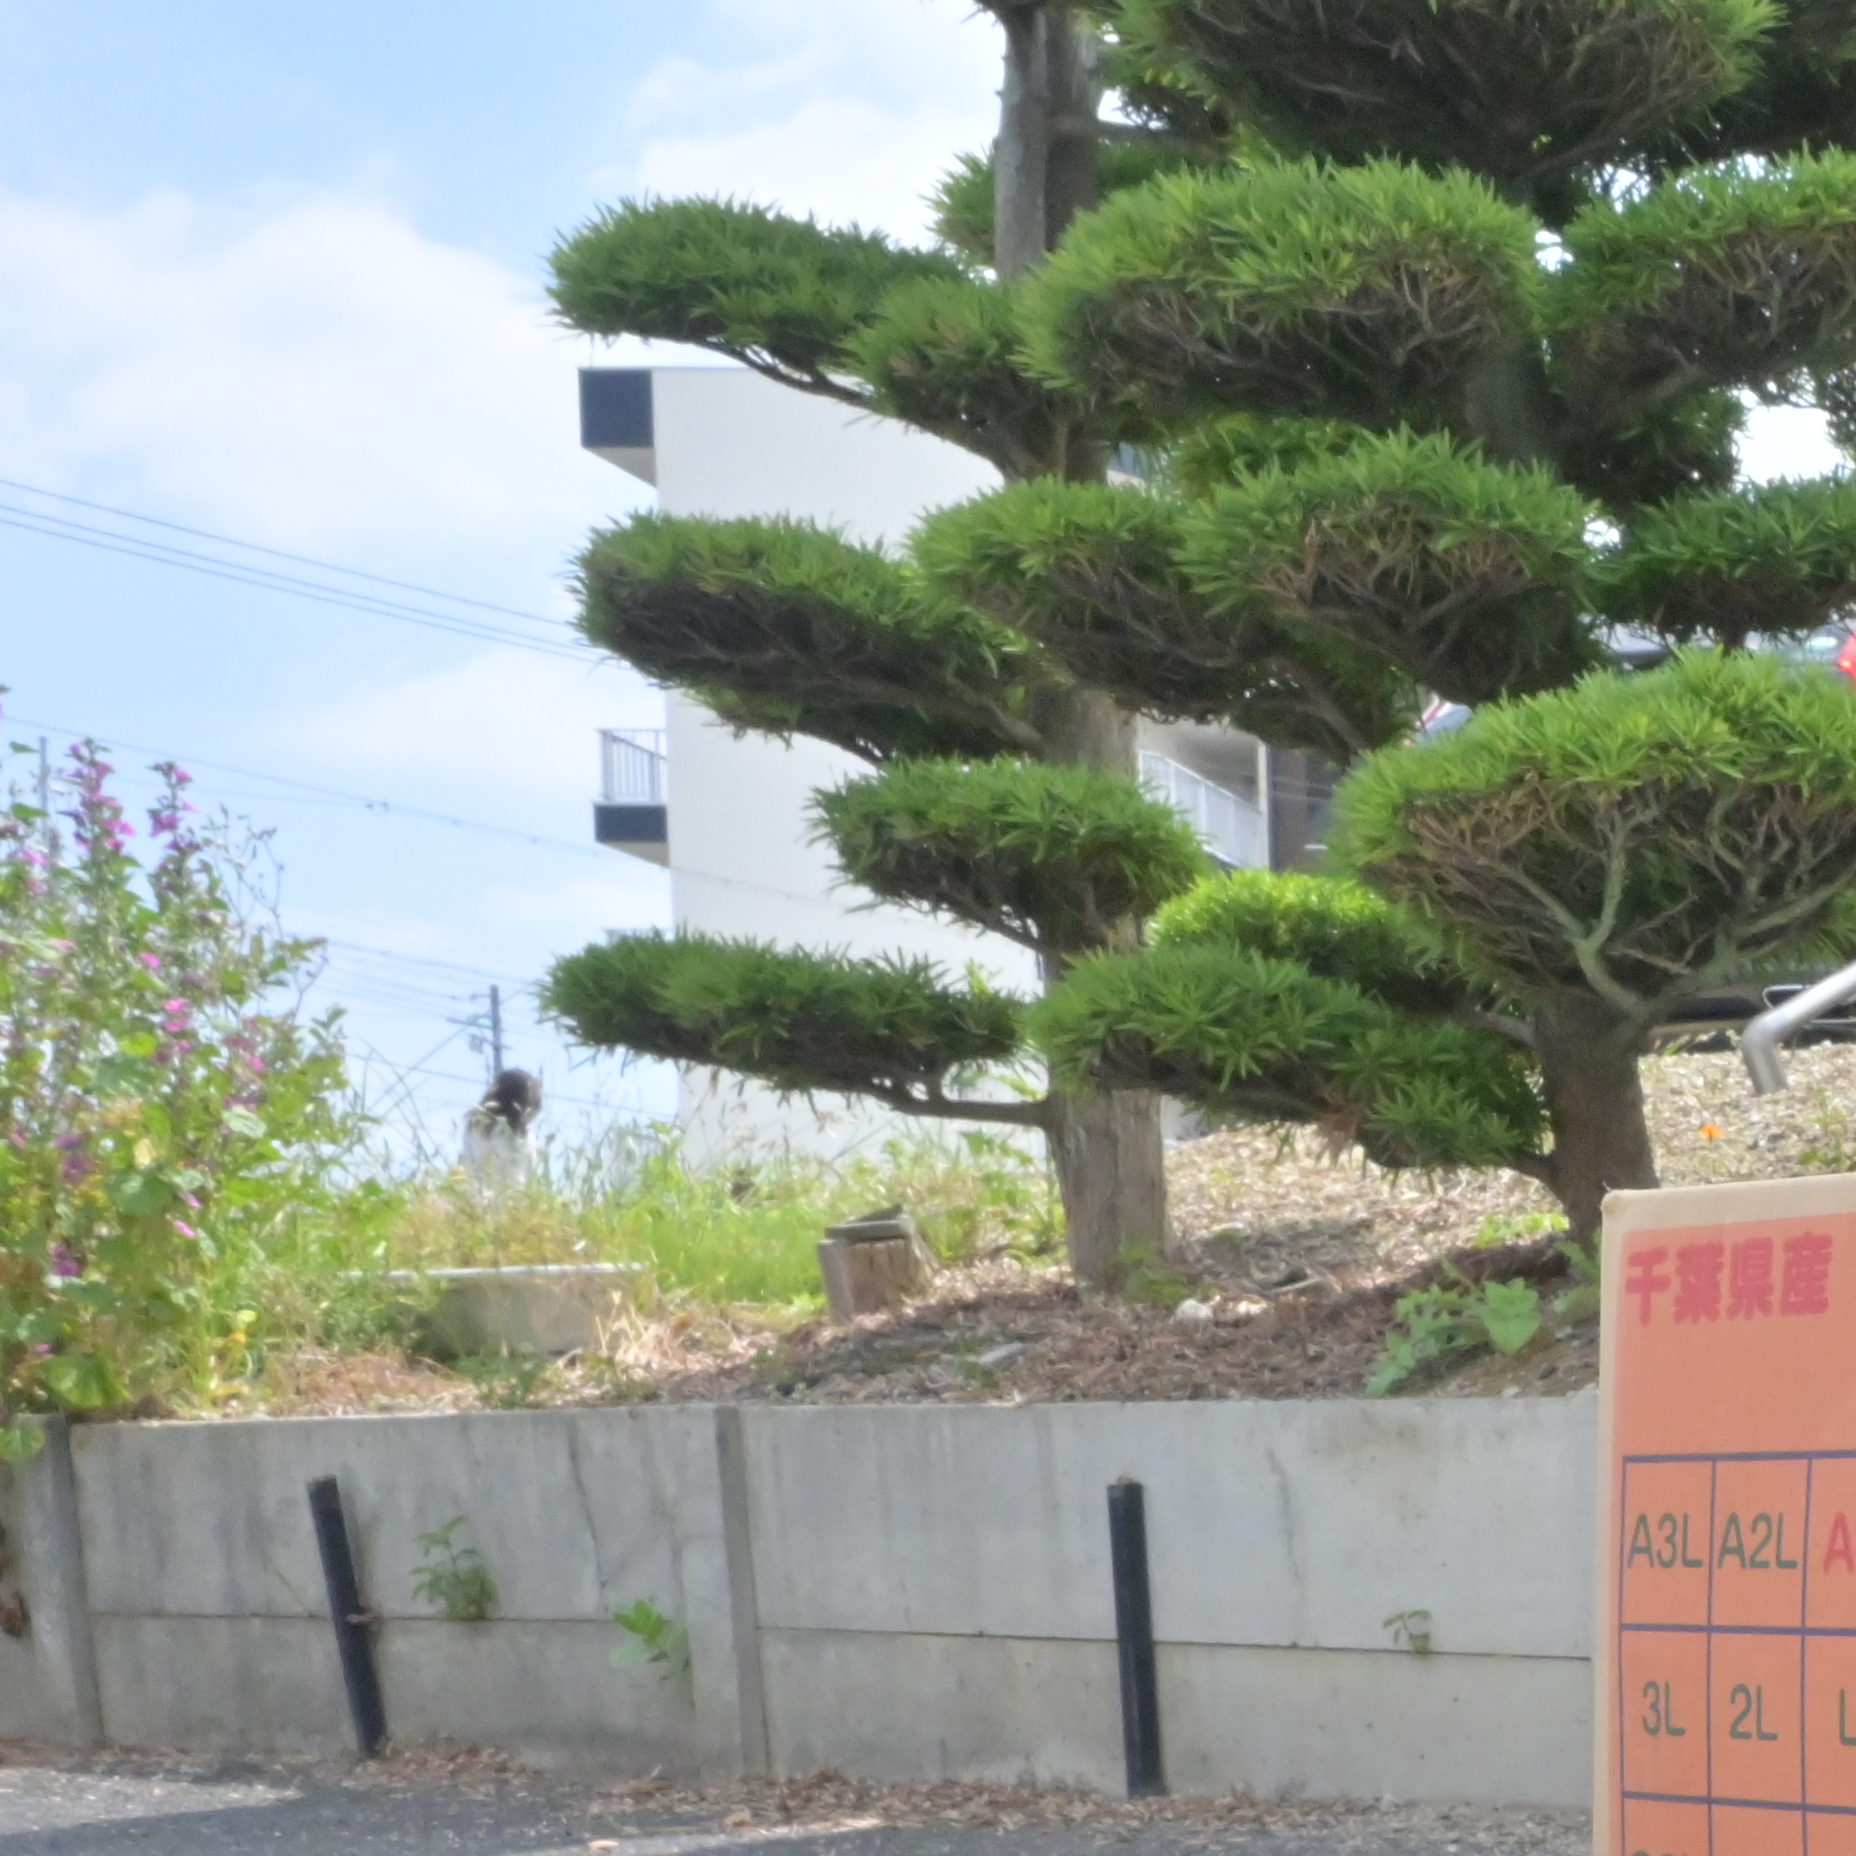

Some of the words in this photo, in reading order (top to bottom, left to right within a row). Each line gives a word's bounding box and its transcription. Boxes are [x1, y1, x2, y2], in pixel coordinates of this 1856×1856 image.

[1624, 1232, 1833, 1326] 千葉県産
[1627, 1511, 1704, 1571] A3L
[1717, 1511, 1798, 1572] A2L
[1641, 1680, 1686, 1738] 3L
[1729, 1682, 1779, 1743] 2L
